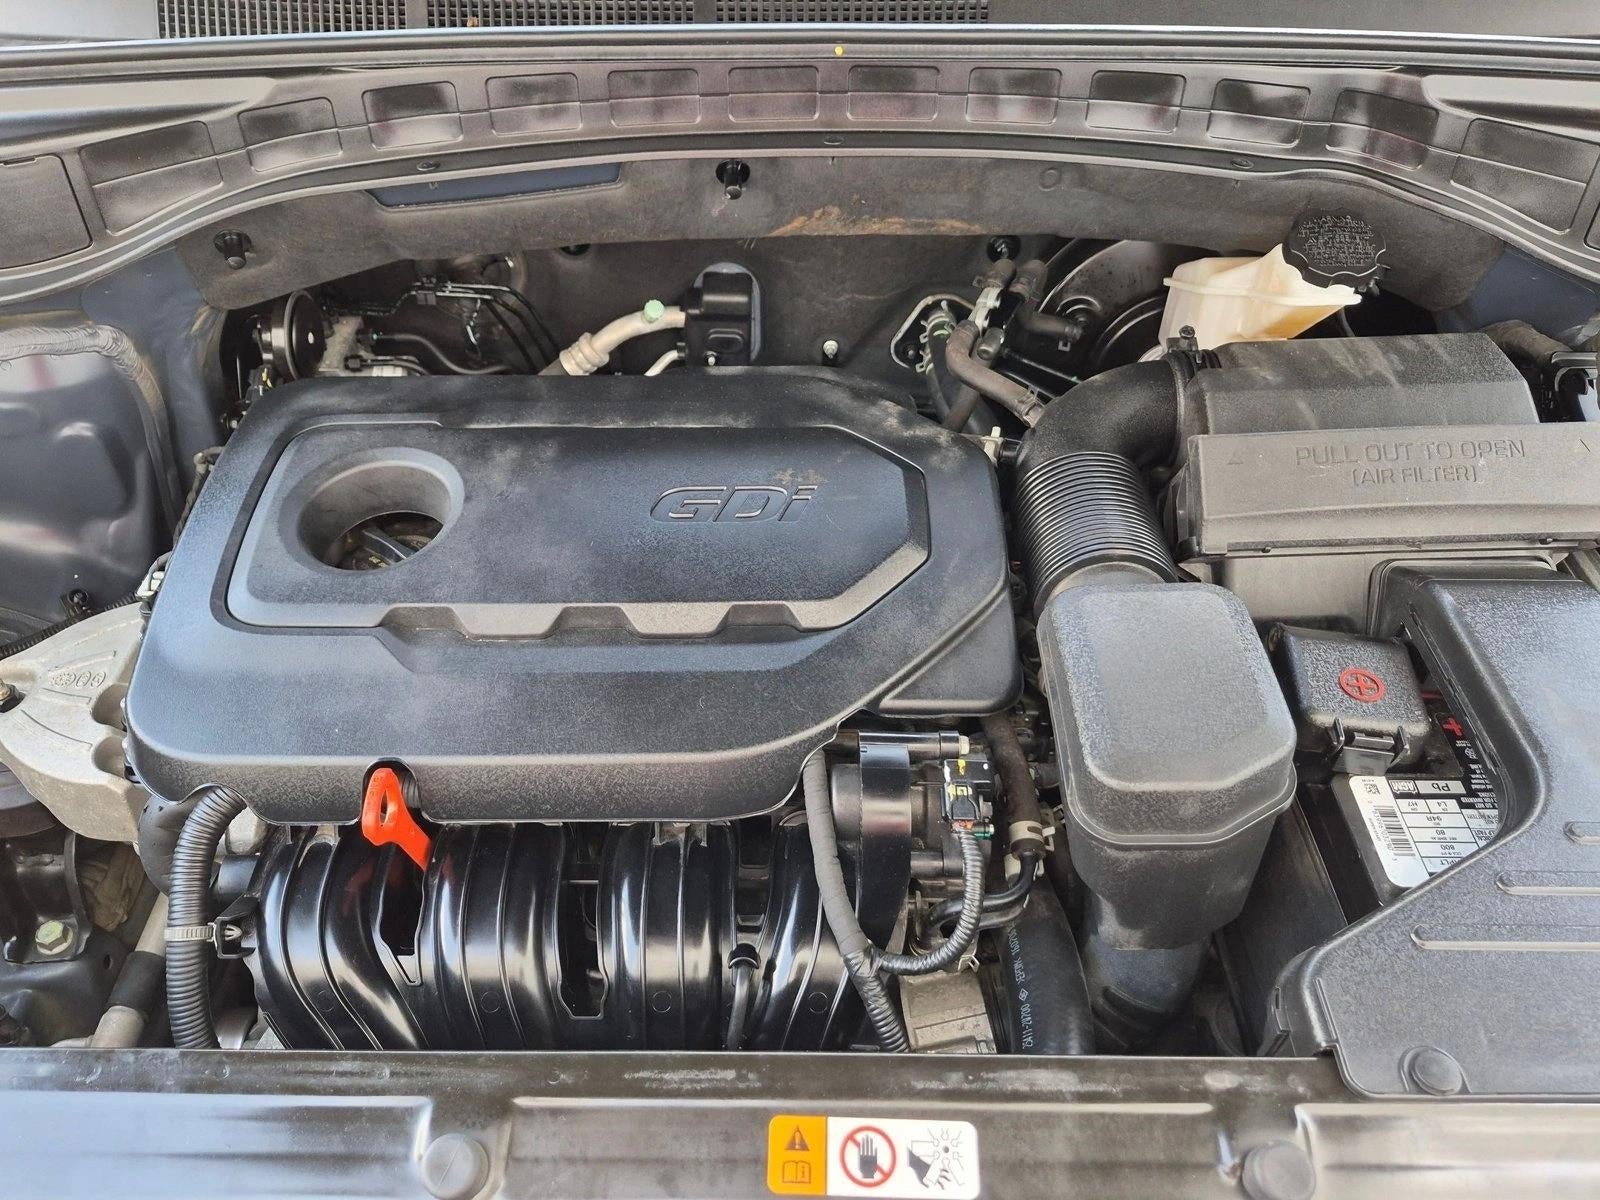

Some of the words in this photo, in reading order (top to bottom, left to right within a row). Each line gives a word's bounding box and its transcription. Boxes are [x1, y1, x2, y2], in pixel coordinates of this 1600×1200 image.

[1296, 445, 1358, 465] PULL
[1366, 442, 1412, 463] OUT
[1424, 441, 1452, 461] TO
[1461, 439, 1525, 459] OPEN
[650, 485, 818, 523] GDi
[1431, 782, 1451, 792] Pb
